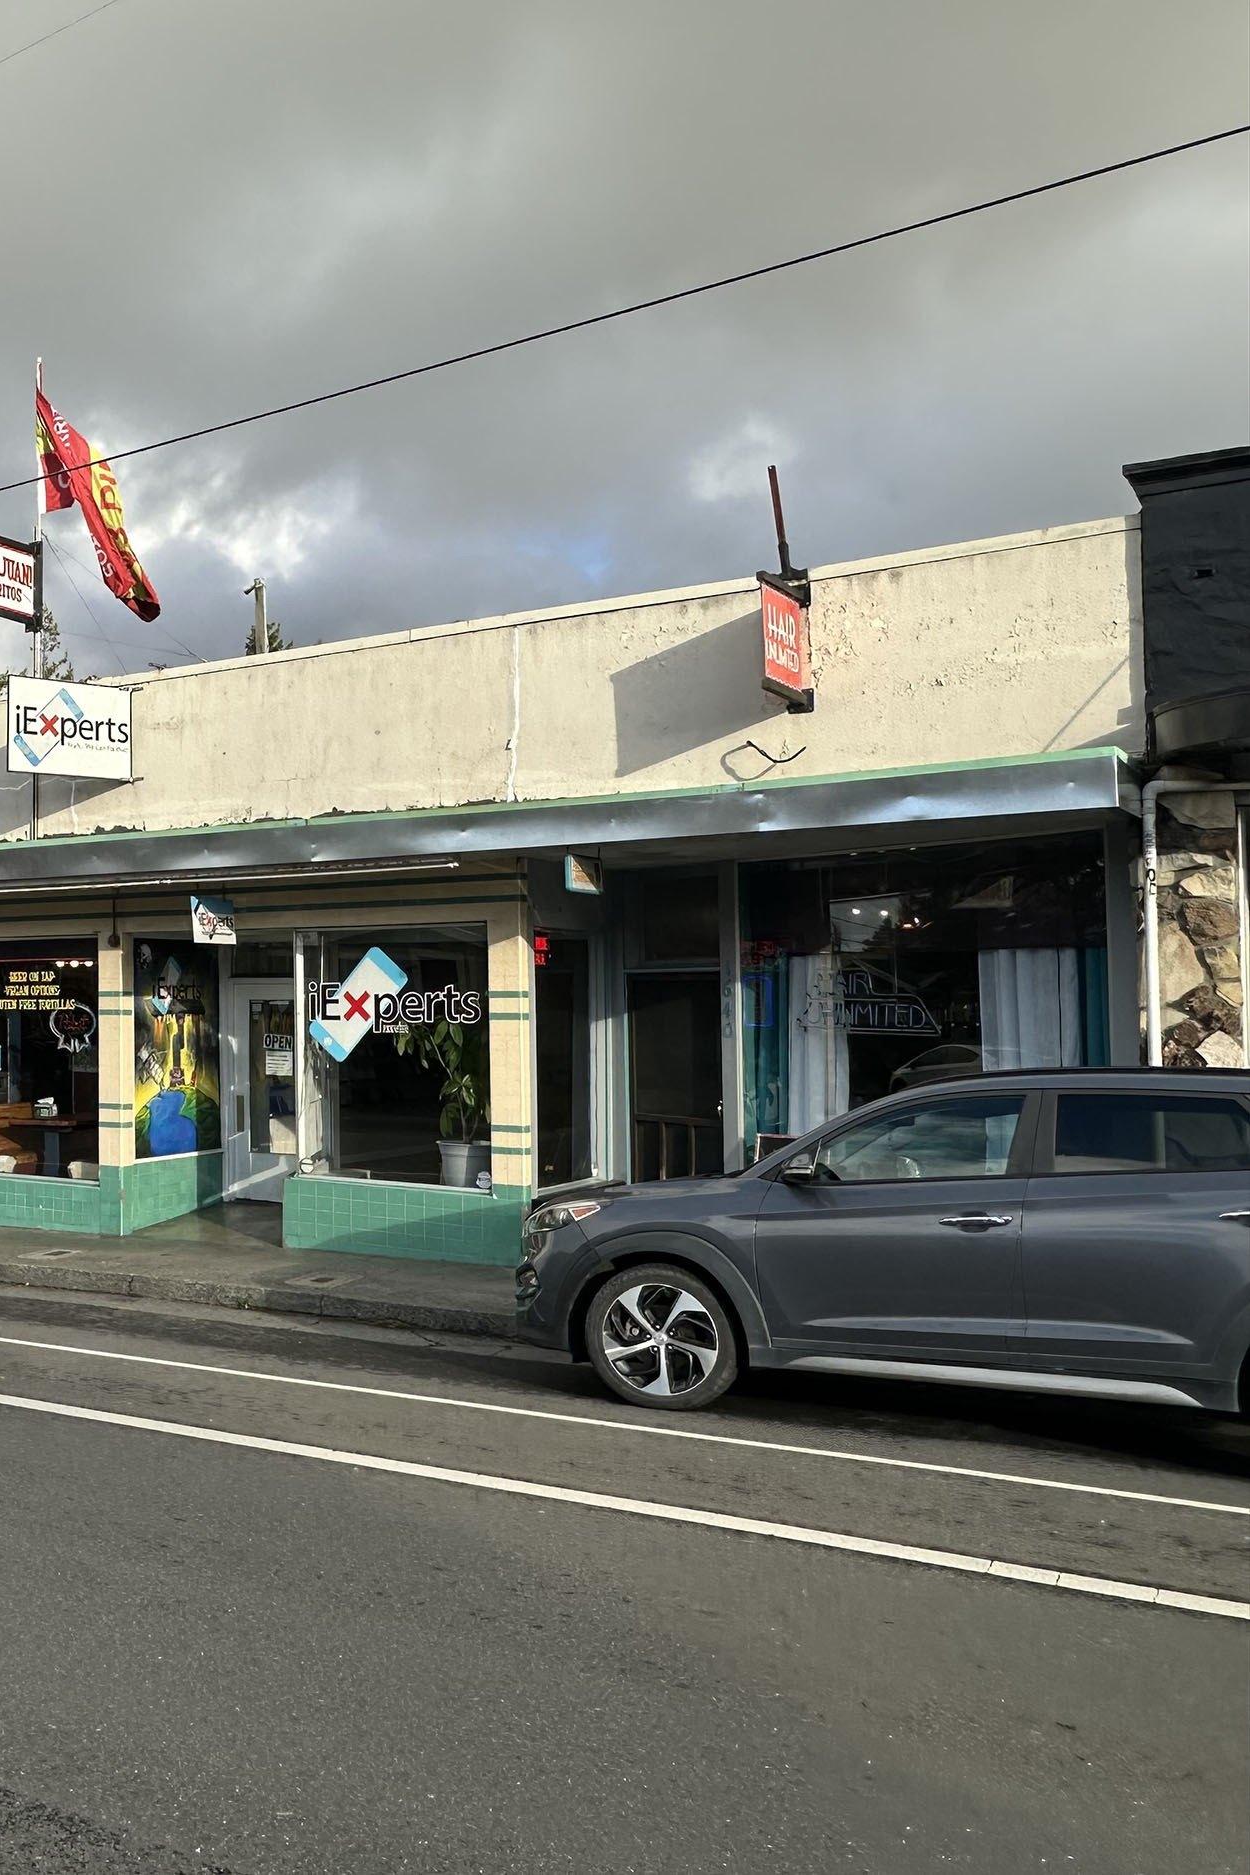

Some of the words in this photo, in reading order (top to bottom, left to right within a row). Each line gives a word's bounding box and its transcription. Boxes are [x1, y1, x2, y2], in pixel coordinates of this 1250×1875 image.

[767, 603, 796, 649] HAIR
[16, 704, 129, 746] iExperts
[18, 999, 37, 1010] FREE
[38, 998, 76, 1010] TORTILLAS
[308, 981, 482, 1034] iExperts
[265, 1034, 292, 1049] OPEN
